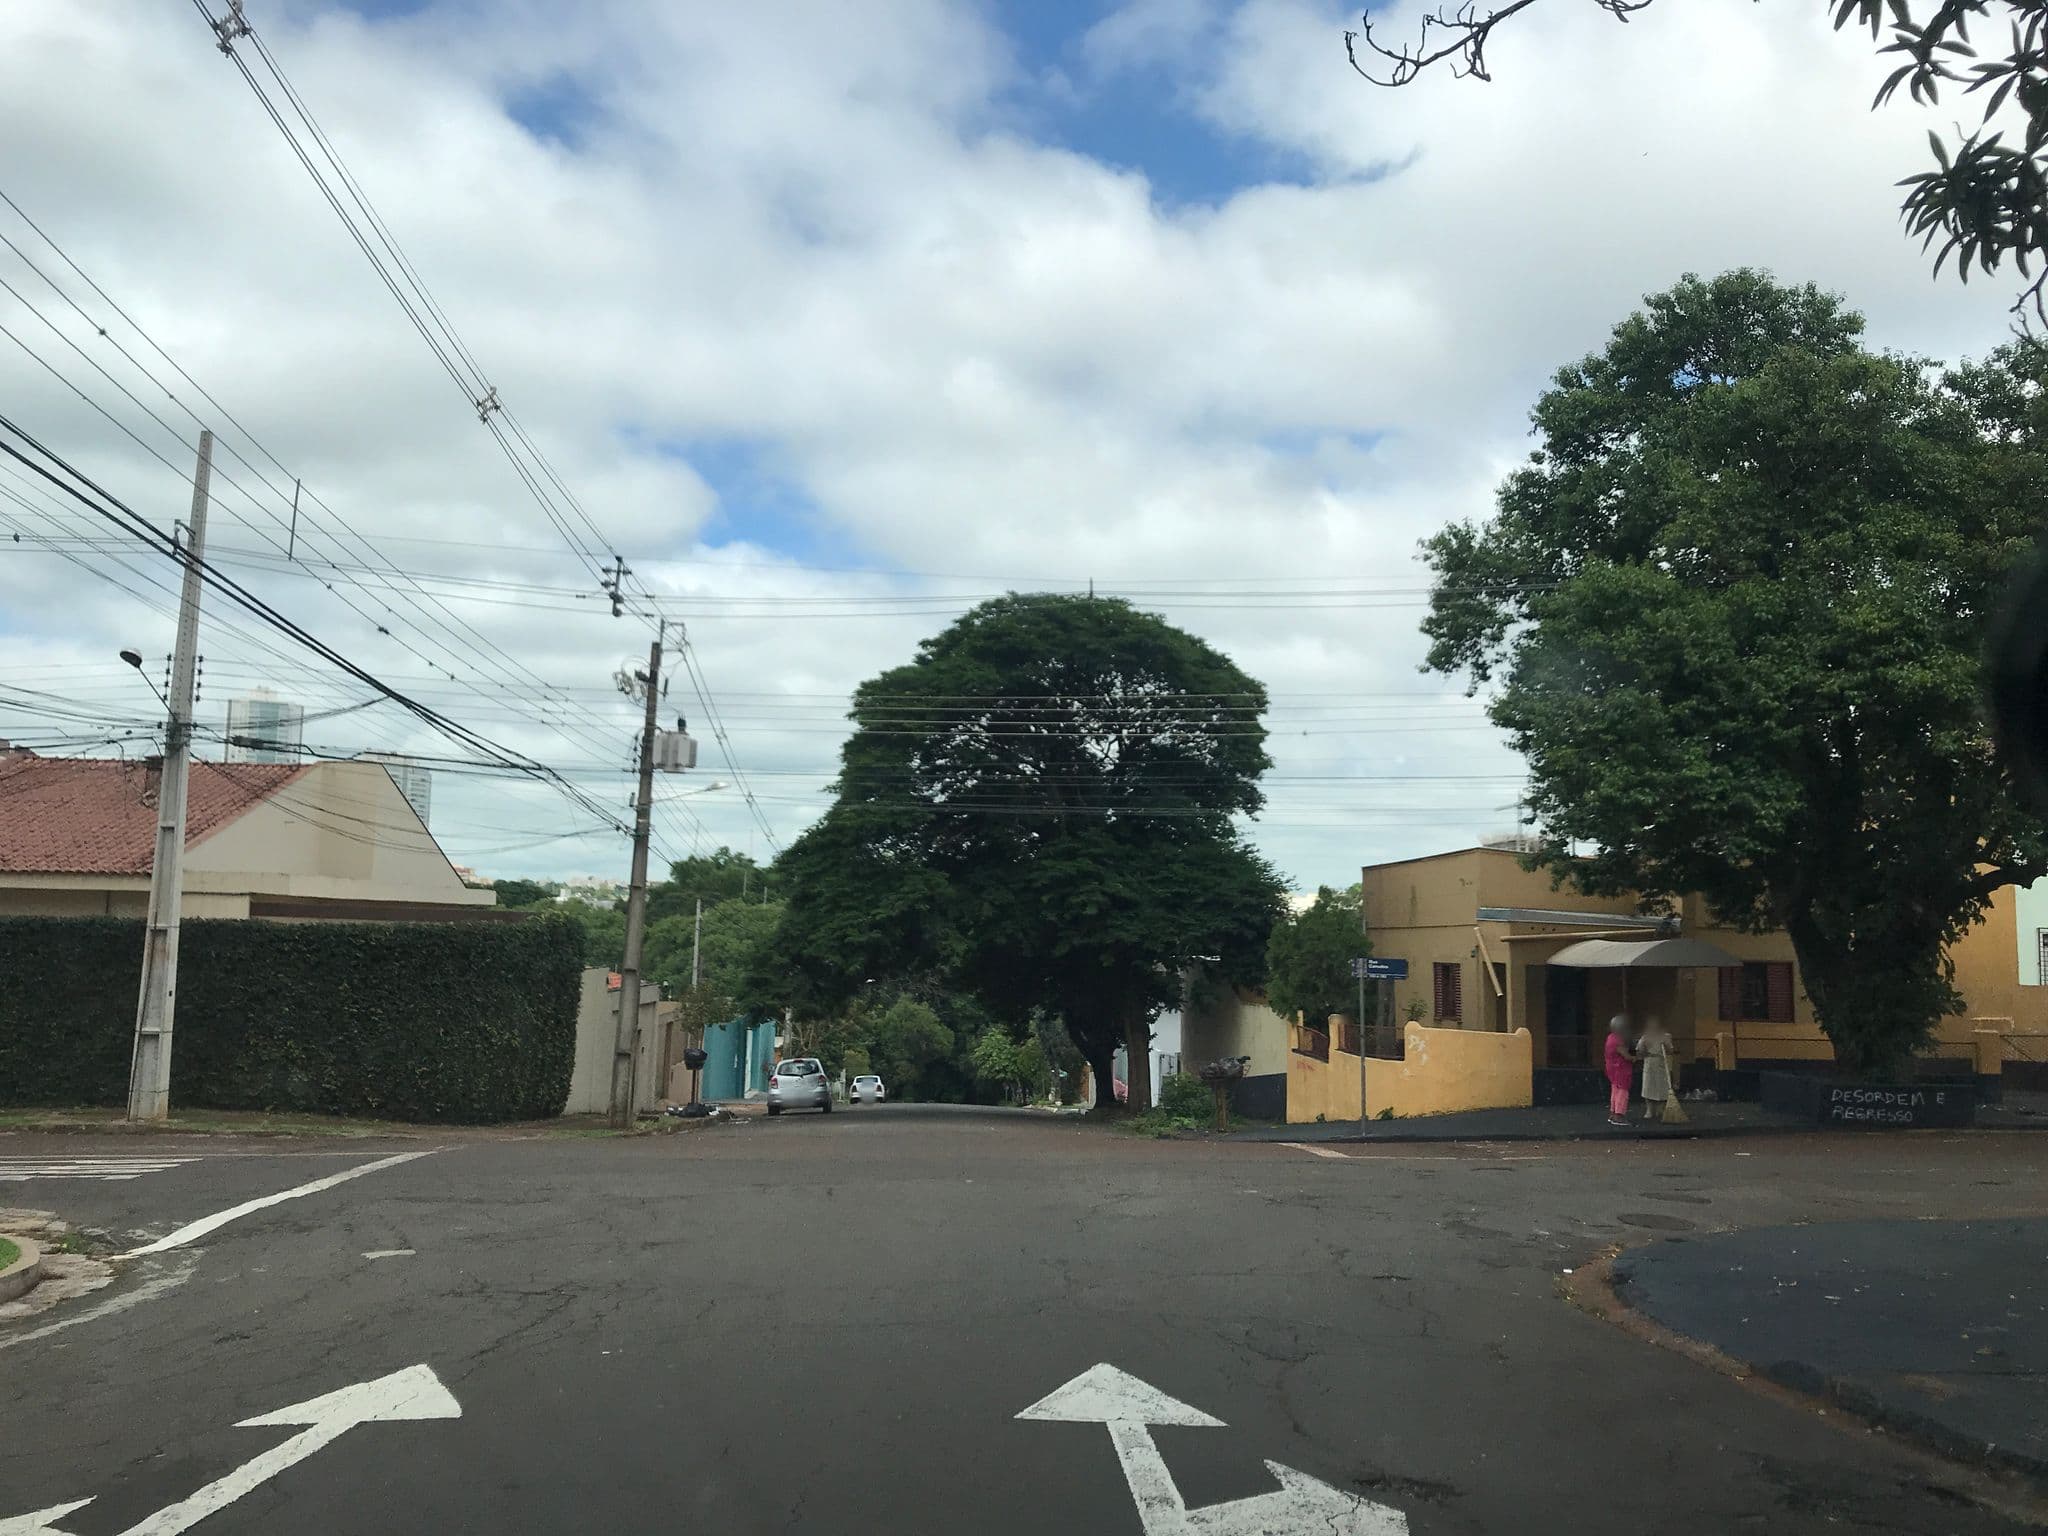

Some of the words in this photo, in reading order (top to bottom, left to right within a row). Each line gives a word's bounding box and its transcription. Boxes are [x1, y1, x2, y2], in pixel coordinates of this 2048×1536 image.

[1831, 1089, 1925, 1106] DESORDEM
[1936, 1092, 1945, 1105] E
[1831, 1105, 1913, 1122] REGRESSO
